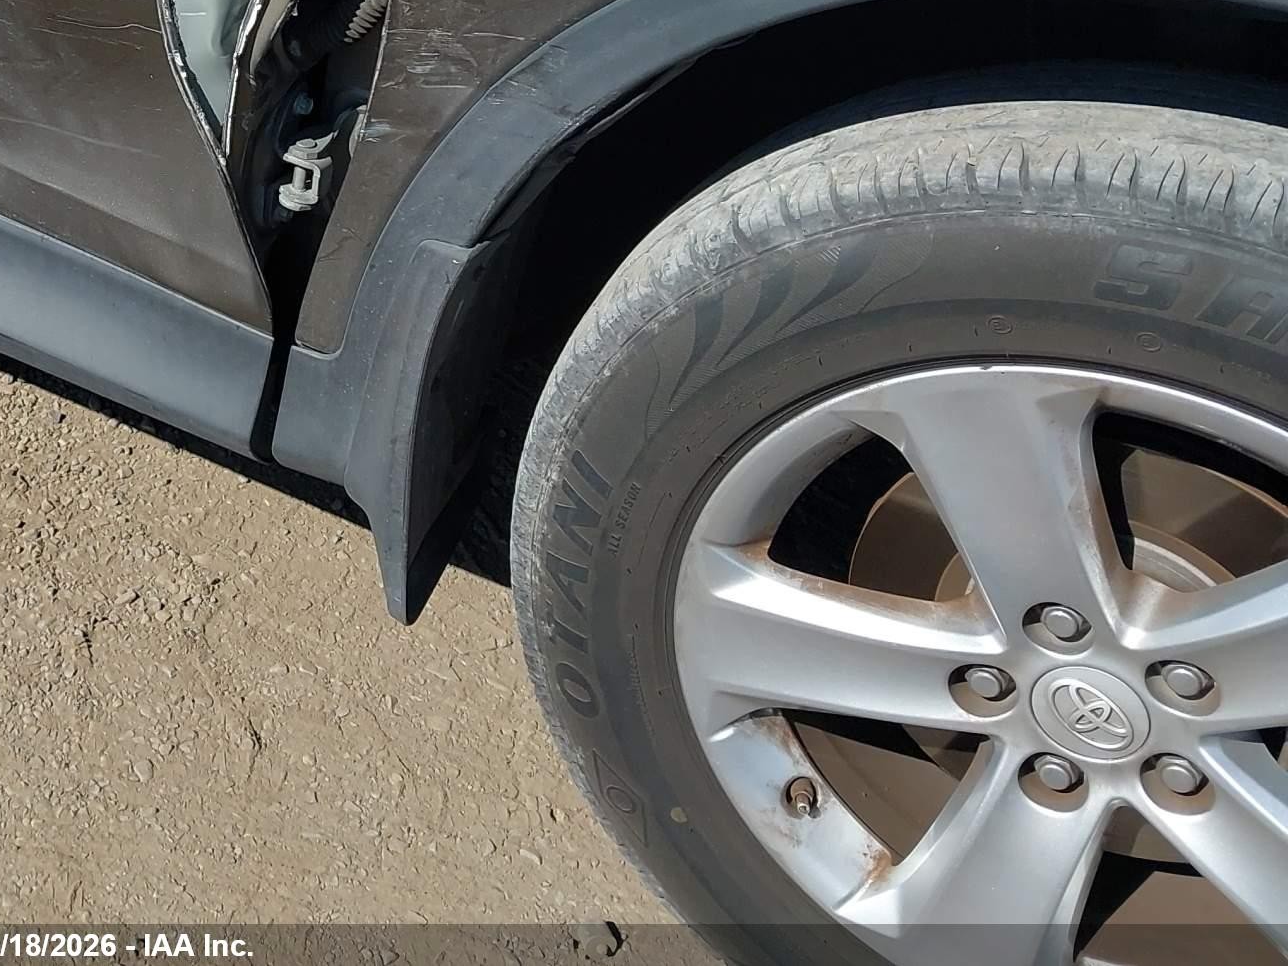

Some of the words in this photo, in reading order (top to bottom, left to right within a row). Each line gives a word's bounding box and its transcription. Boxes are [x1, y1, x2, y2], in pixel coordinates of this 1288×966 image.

[545, 449, 613, 718] OTANI
[608, 533, 623, 558] ALL
[616, 482, 642, 529] SEASON
